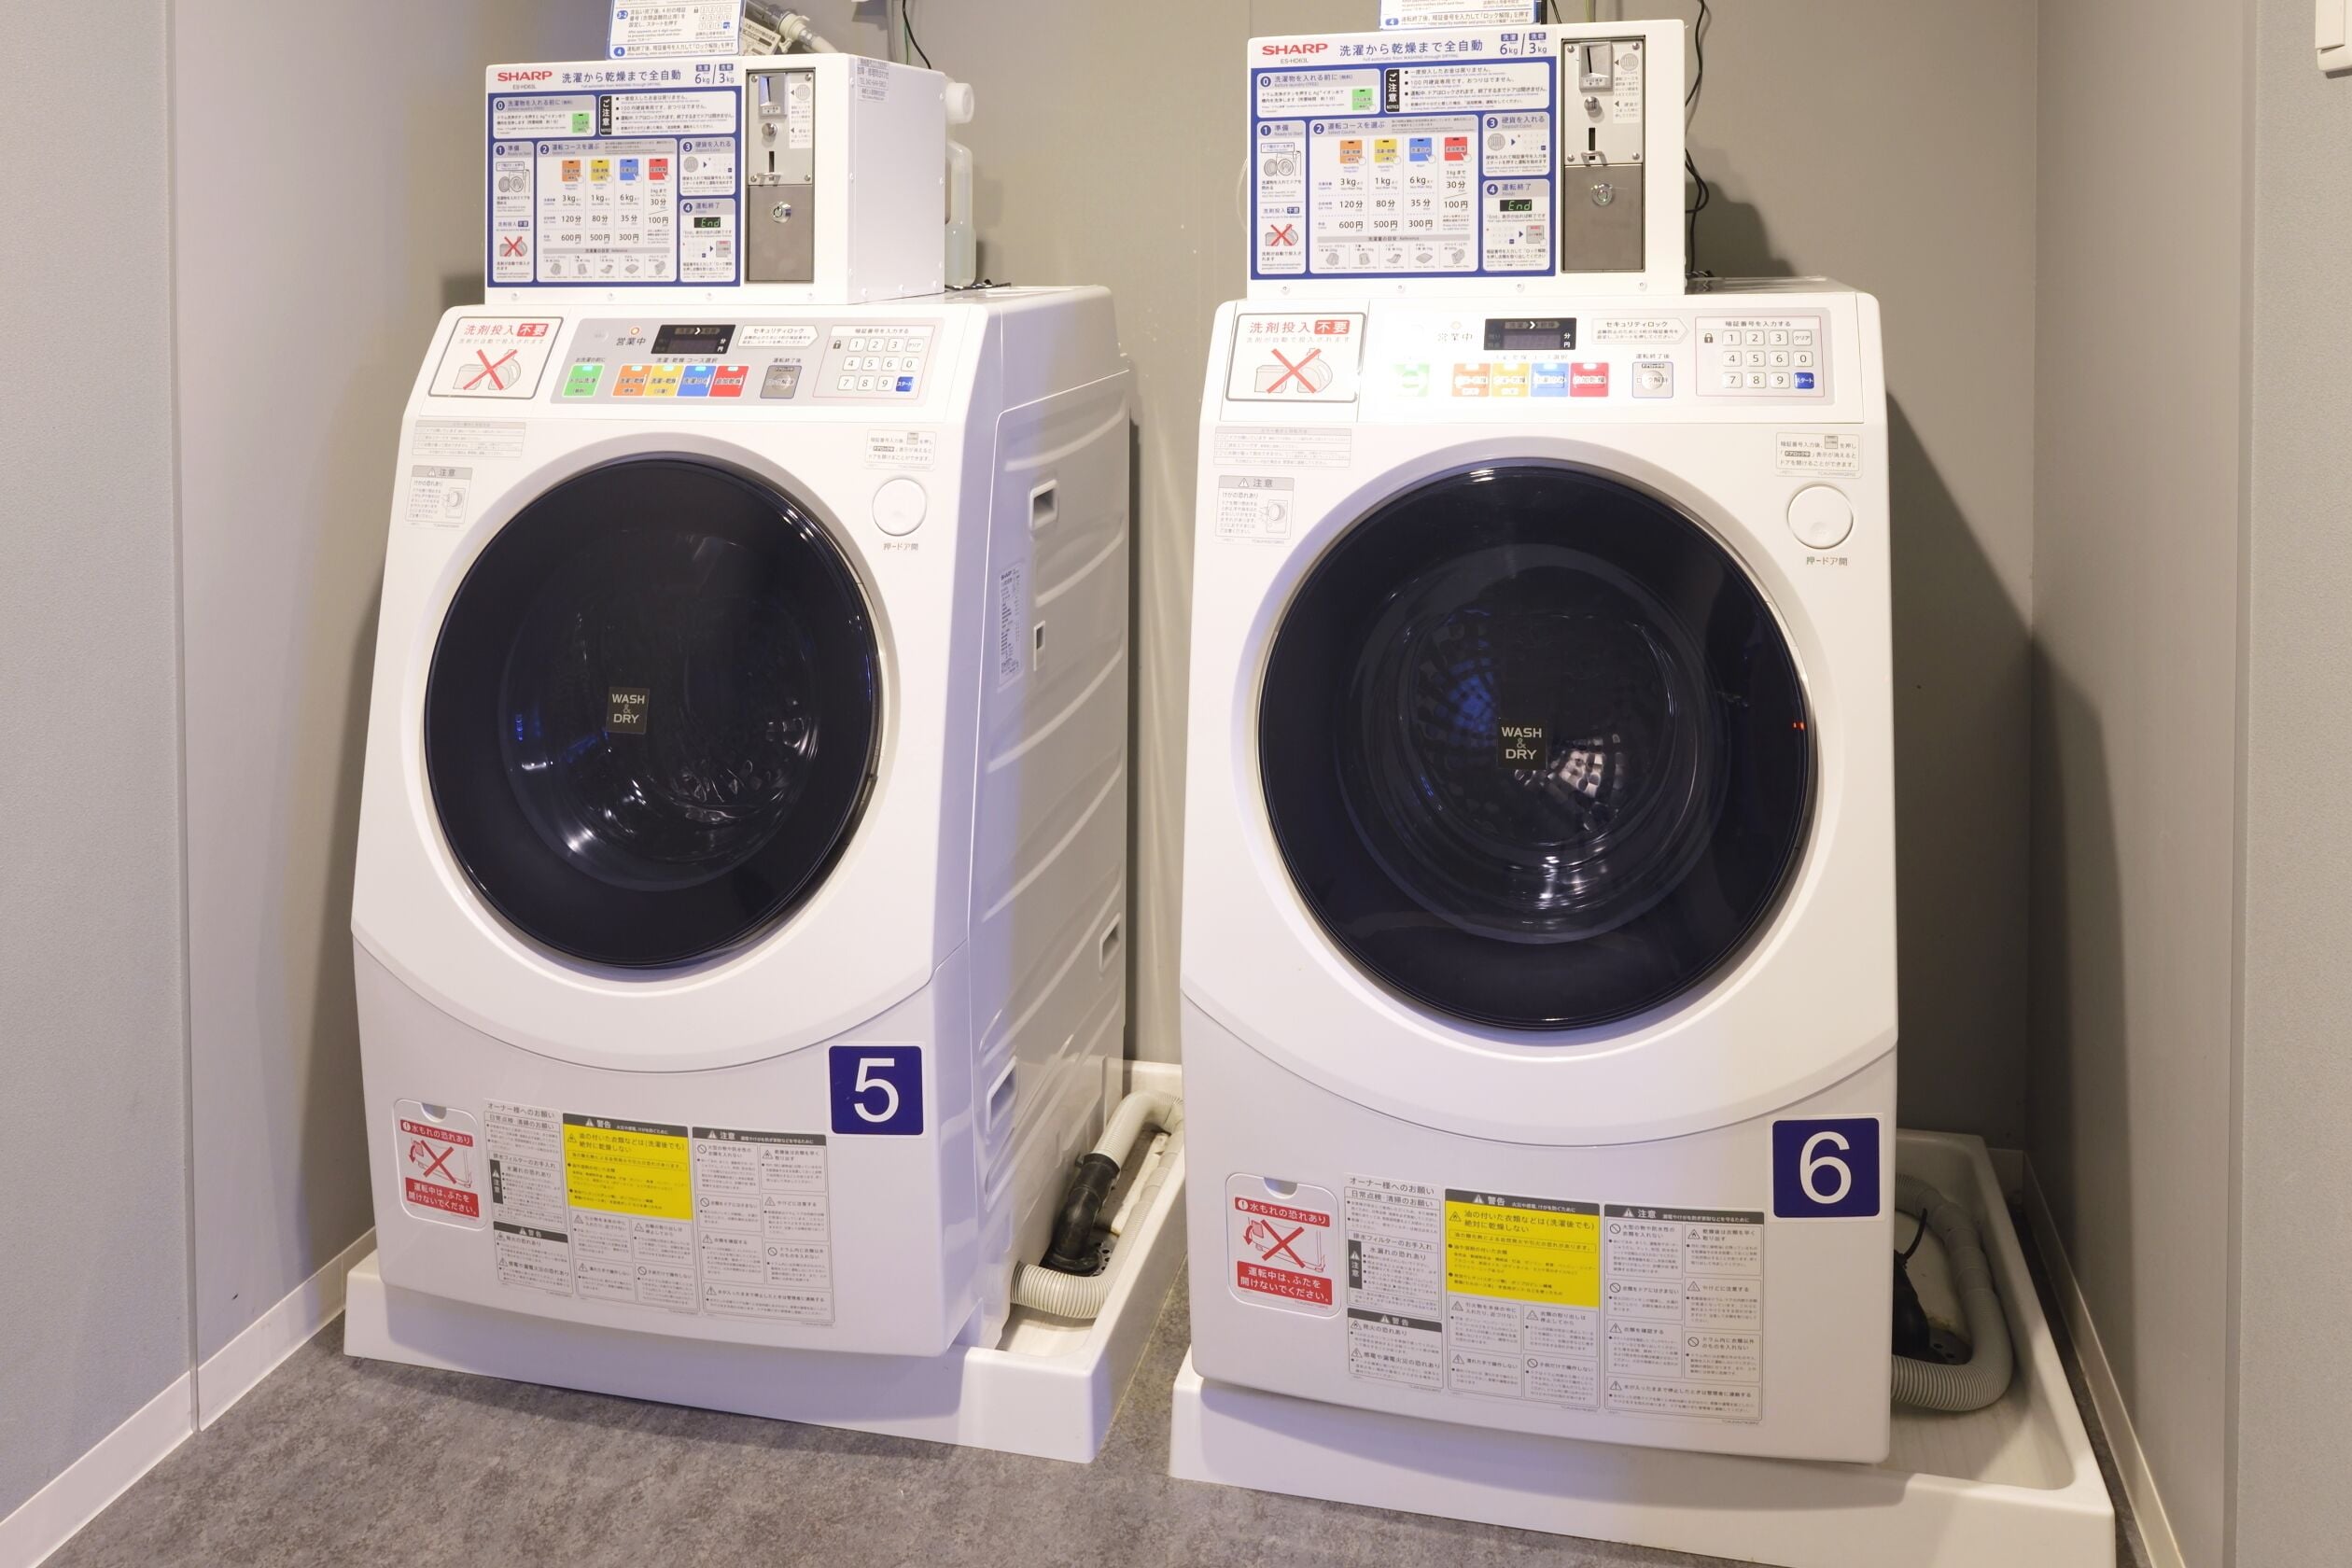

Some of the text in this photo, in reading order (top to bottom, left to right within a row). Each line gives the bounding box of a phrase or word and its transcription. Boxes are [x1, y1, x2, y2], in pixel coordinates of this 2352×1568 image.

[1262, 43, 1328, 55] SHARP
[1339, 39, 1483, 57] 洗濯から乾燥まで全自動
[497, 70, 553, 82] SHARP
[562, 70, 681, 84] 洗濯から乾燥まで全自動
[1502, 116, 1546, 124] 硬貨を入れる
[1327, 121, 1385, 130] 運転コースを選ぶ
[1339, 177, 1356, 186] 3kg
[1375, 177, 1391, 186] 1kg
[1409, 176, 1426, 185] 6kg
[1502, 183, 1532, 191] 運転終了
[562, 194, 576, 203] 3kg
[591, 194, 605, 203] 1kg
[620, 193, 634, 203] 6kg
[1410, 199, 1431, 207] 35分
[1339, 200, 1363, 208] 120分
[1508, 199, 1533, 211] End
[561, 215, 581, 223] 120分
[592, 215, 608, 223] 80分
[621, 215, 637, 223] 35分
[701, 217, 721, 227] End
[1408, 219, 1433, 228] 300円
[1338, 220, 1363, 229] 600円
[1373, 220, 1398, 229] 500円
[561, 233, 581, 242] 600円
[590, 233, 610, 242] 500円
[619, 232, 639, 242] 300円
[464, 324, 515, 336] 洗剤投入
[1250, 321, 1310, 334] 洗剤投入
[616, 337, 646, 346] 営業中
[873, 341, 878, 349] 2
[892, 341, 899, 349] 3
[848, 359, 913, 368] 4 5 6 0
[1753, 376, 1759, 385] 8
[1776, 376, 1783, 385] 9
[439, 469, 456, 477] 注意
[1253, 478, 1273, 488] 注意
[612, 693, 645, 705] WASH
[623, 704, 631, 714] &
[613, 713, 640, 724] DRY
[1501, 726, 1542, 738] WASH
[1517, 737, 1527, 749] &
[1505, 749, 1537, 760] DRY
[854, 1057, 899, 1123] 5
[487, 1102, 555, 1119] オーナー様へのお願い
[596, 1120, 611, 1128] 警告
[411, 1126, 470, 1146] 水もれの恐れあり
[720, 1131, 735, 1141] 注意
[494, 1153, 556, 1169] 排水フィルターのお手入れ
[1799, 1130, 1852, 1204] 6
[1350, 1177, 1435, 1196] オーナー様へのお願い
[413, 1183, 470, 1203] 運転中は、ふたを
[408, 1192, 477, 1215] 開けないでください。
[1488, 1197, 1505, 1206] 警告
[1251, 1203, 1326, 1224] 水もれの恐れあり
[1637, 1209, 1657, 1218] 注意
[1464, 1220, 1530, 1233] 絶対に乾燥しない
[1353, 1232, 1433, 1251] 排水フィルターのお手入れ
[1248, 1267, 1322, 1289] 運転中は、ふたを
[1240, 1276, 1329, 1303] 開けないでください。
[1392, 1317, 1409, 1326] 警告
